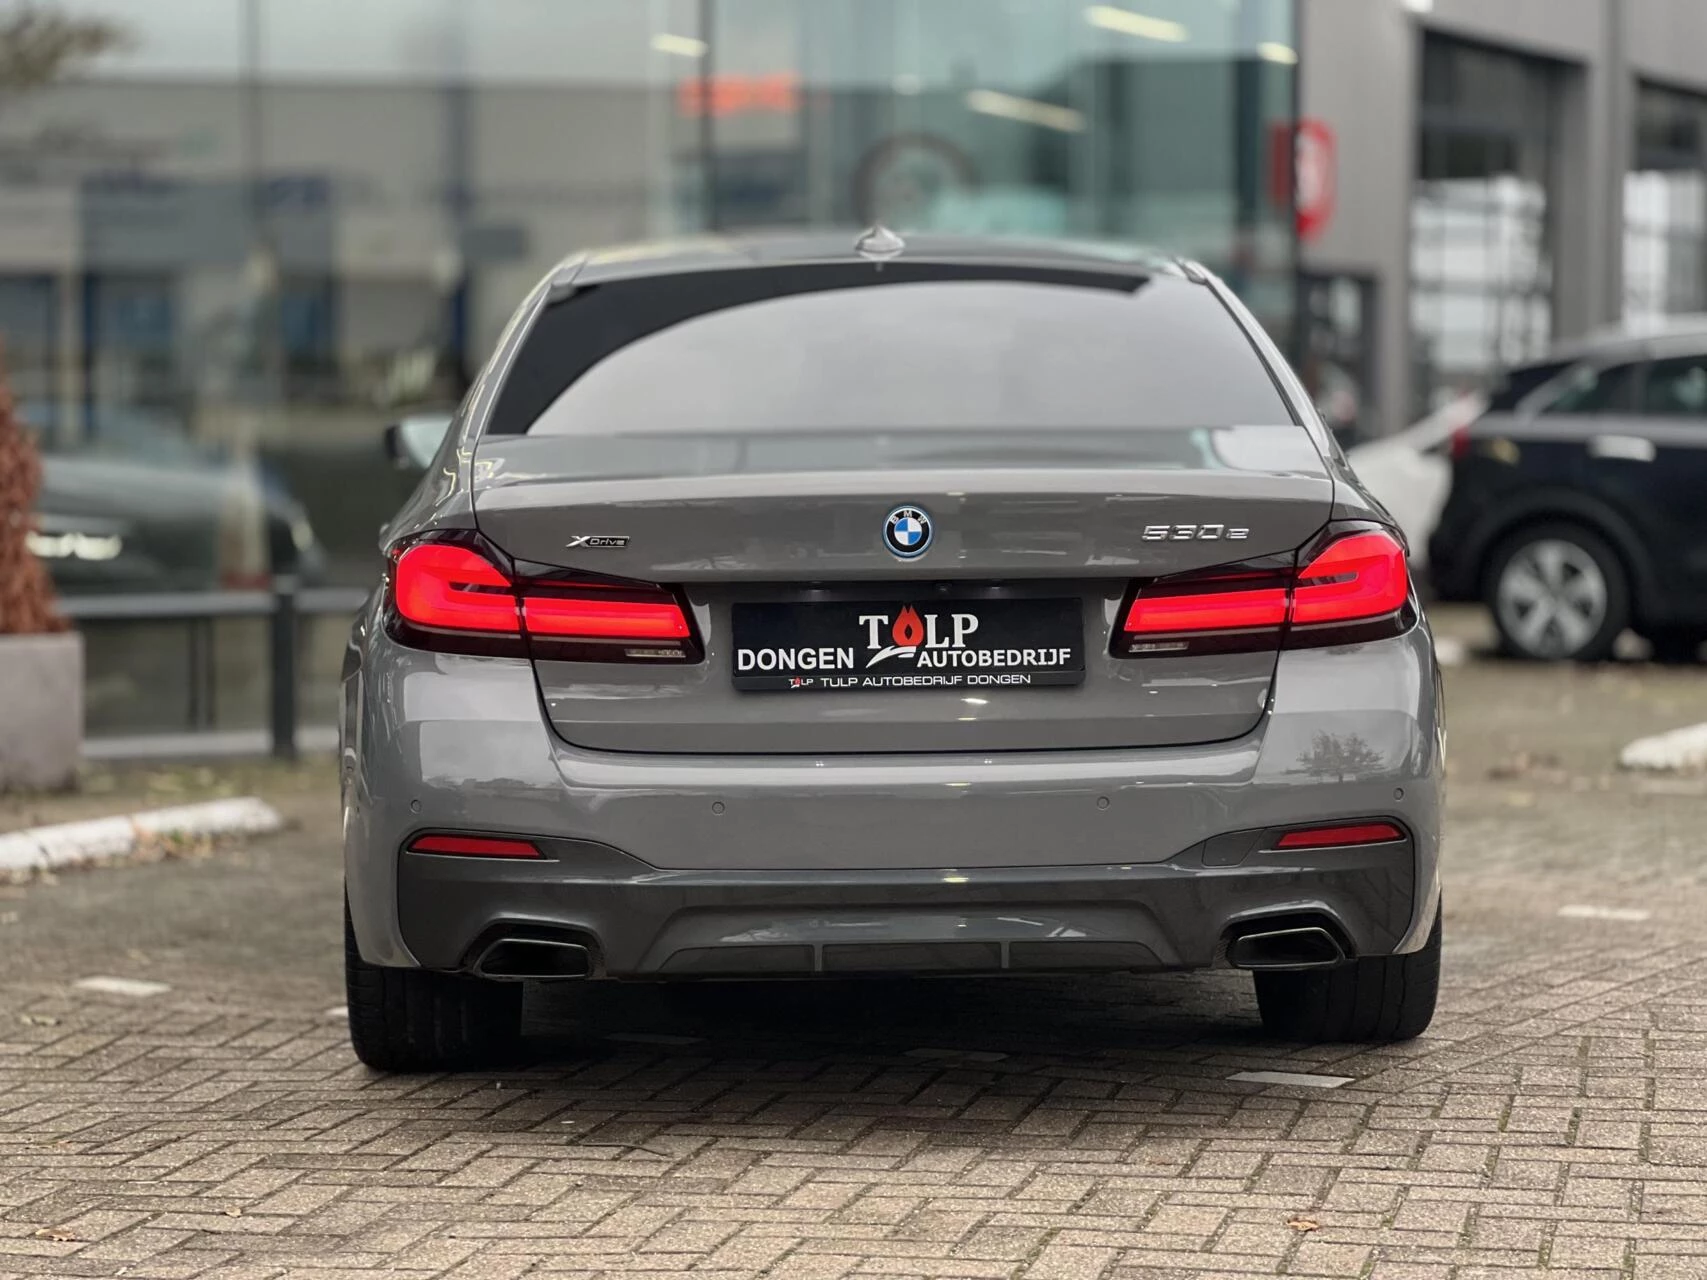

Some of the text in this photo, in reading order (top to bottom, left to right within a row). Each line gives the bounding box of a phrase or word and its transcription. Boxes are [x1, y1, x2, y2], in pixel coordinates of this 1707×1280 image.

[738, 647, 1071, 670] DONGEN AUTOBEDRIJF
[820, 677, 858, 688] TULP
[862, 675, 963, 687] AUTOBEDRIJF
[967, 674, 1031, 685] DONGEN
